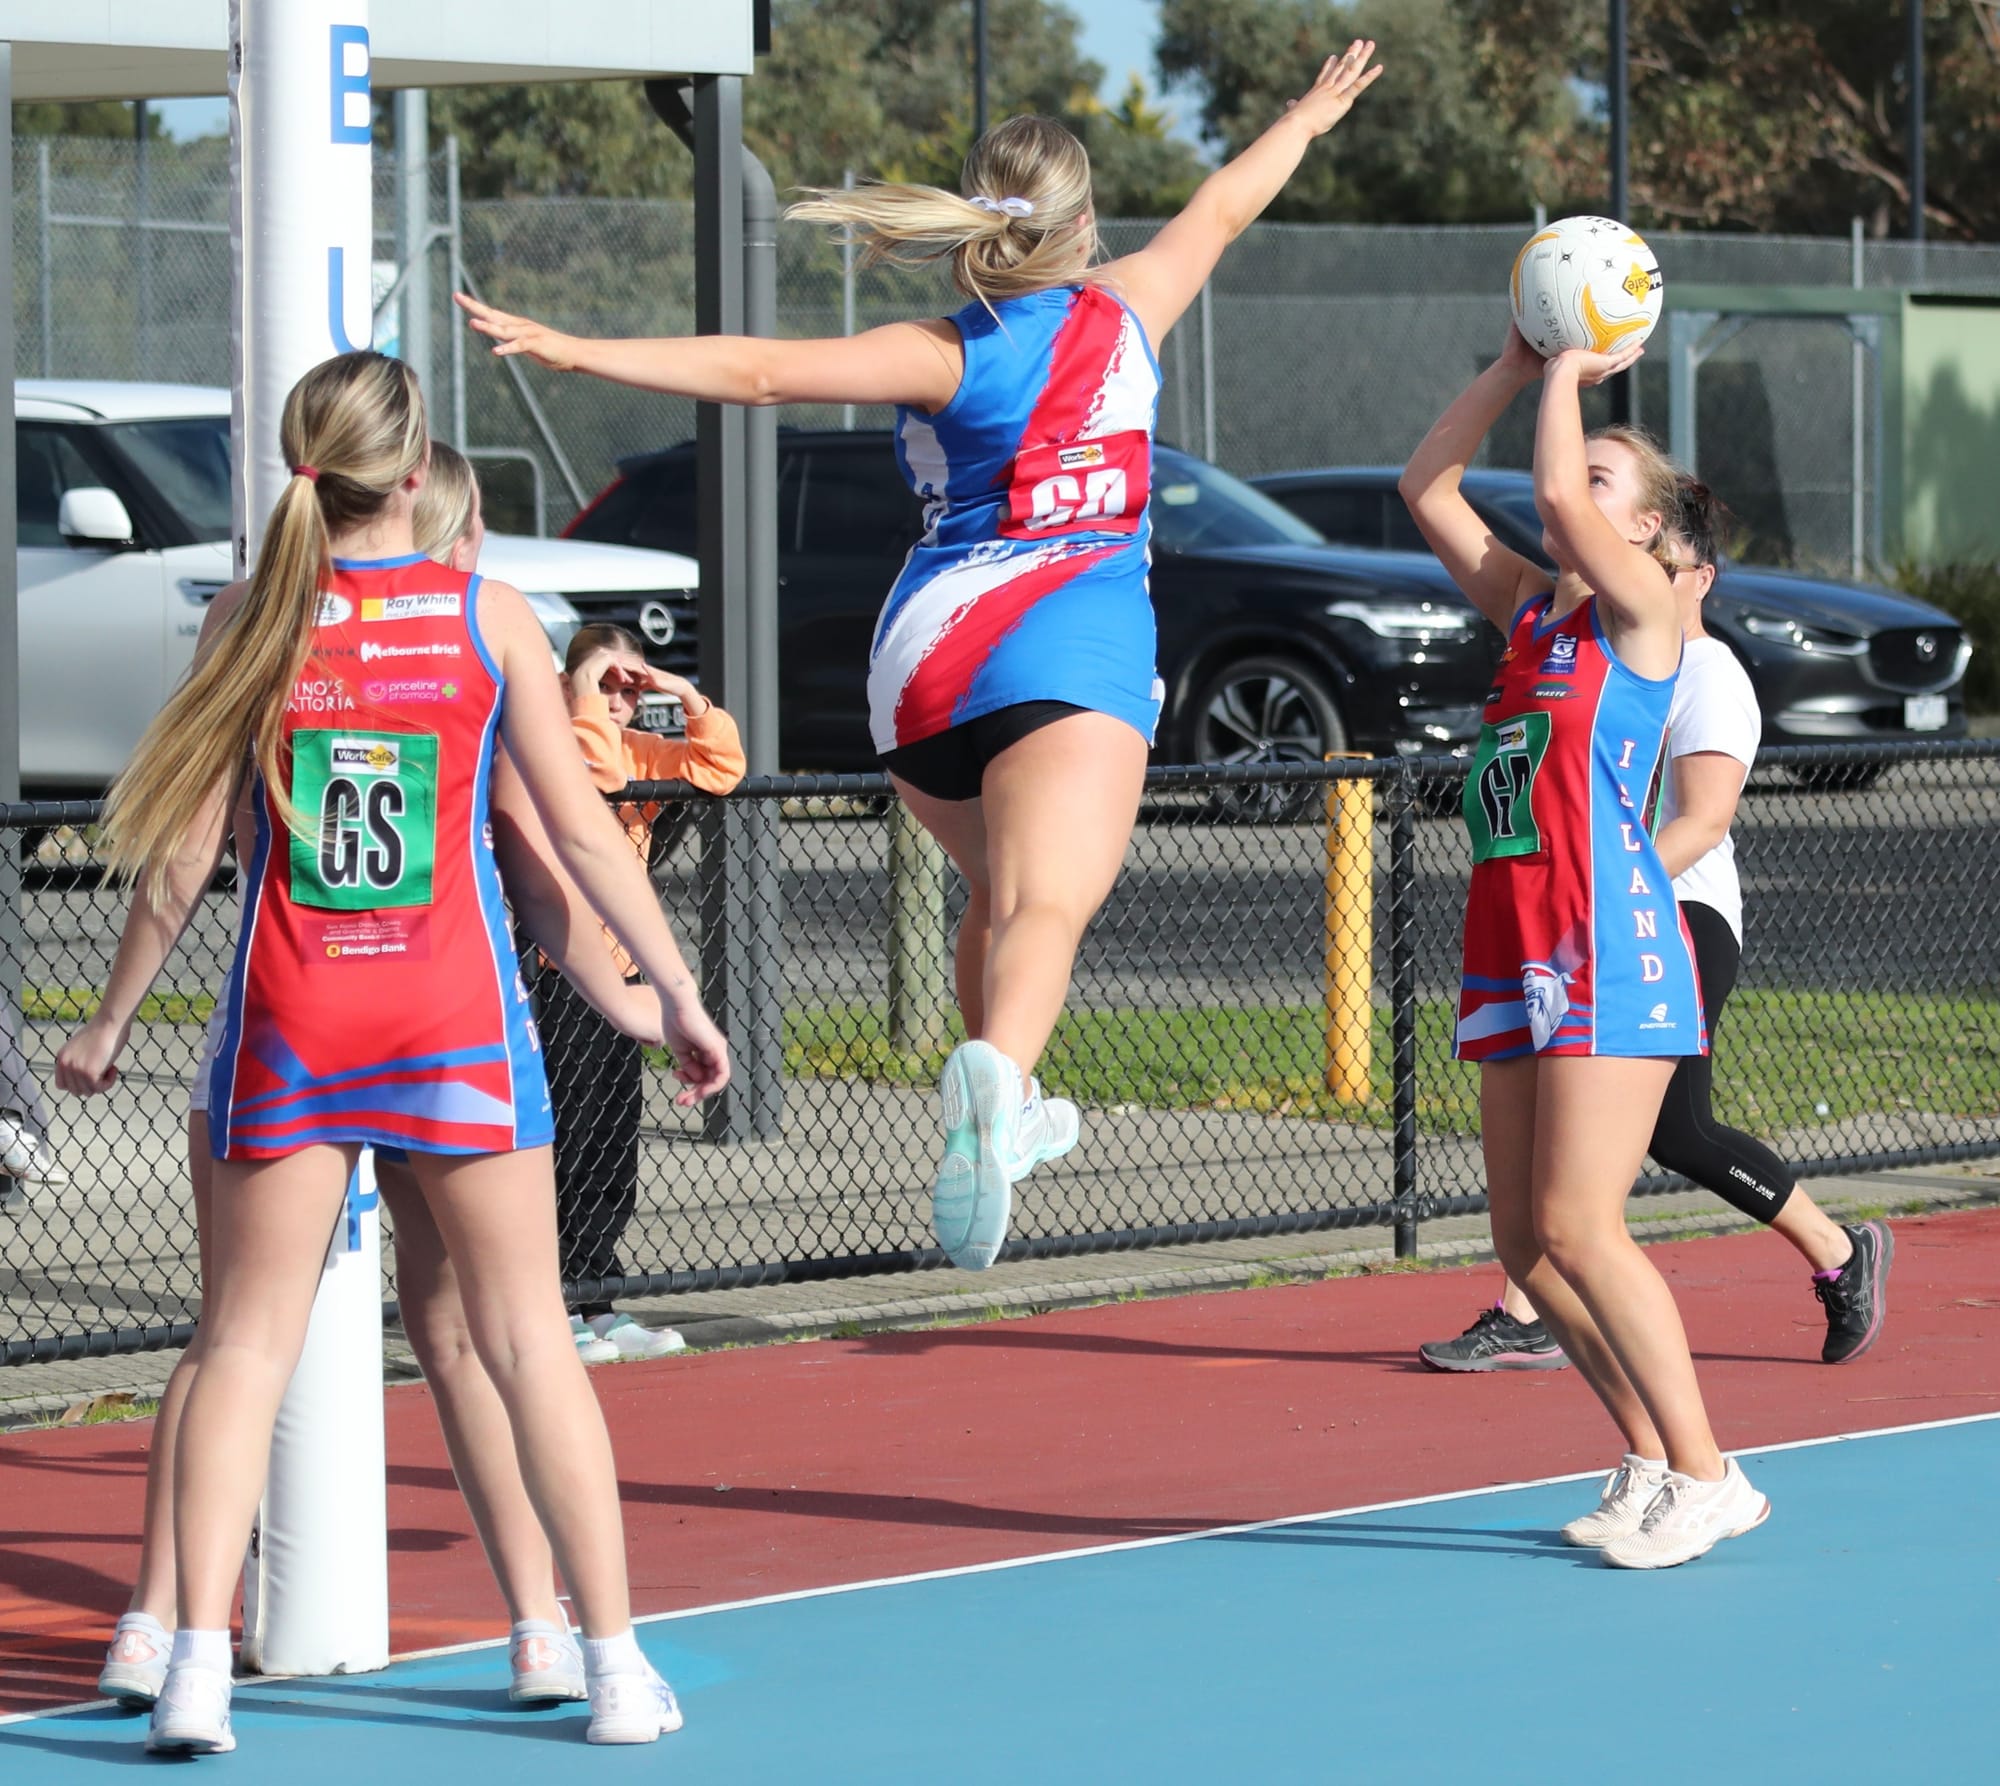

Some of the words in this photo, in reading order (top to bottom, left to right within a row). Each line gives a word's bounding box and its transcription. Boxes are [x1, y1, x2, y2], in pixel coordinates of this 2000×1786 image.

[386, 597, 414, 609] Ray
[416, 594, 457, 606] White
[361, 642, 430, 662] Melbourne
[432, 645, 461, 655] Brick
[294, 679, 344, 697] INO'S
[389, 681, 437, 693] priceline
[389, 691, 438, 701] pharmacy
[287, 694, 355, 712] ATTORIA
[318, 777, 405, 889] GS
[342, 946, 380, 956] Bendigo
[381, 944, 406, 952] Bank
[1729, 1165, 1757, 1189] LORNA
[1755, 1184, 1776, 1201] JANE
